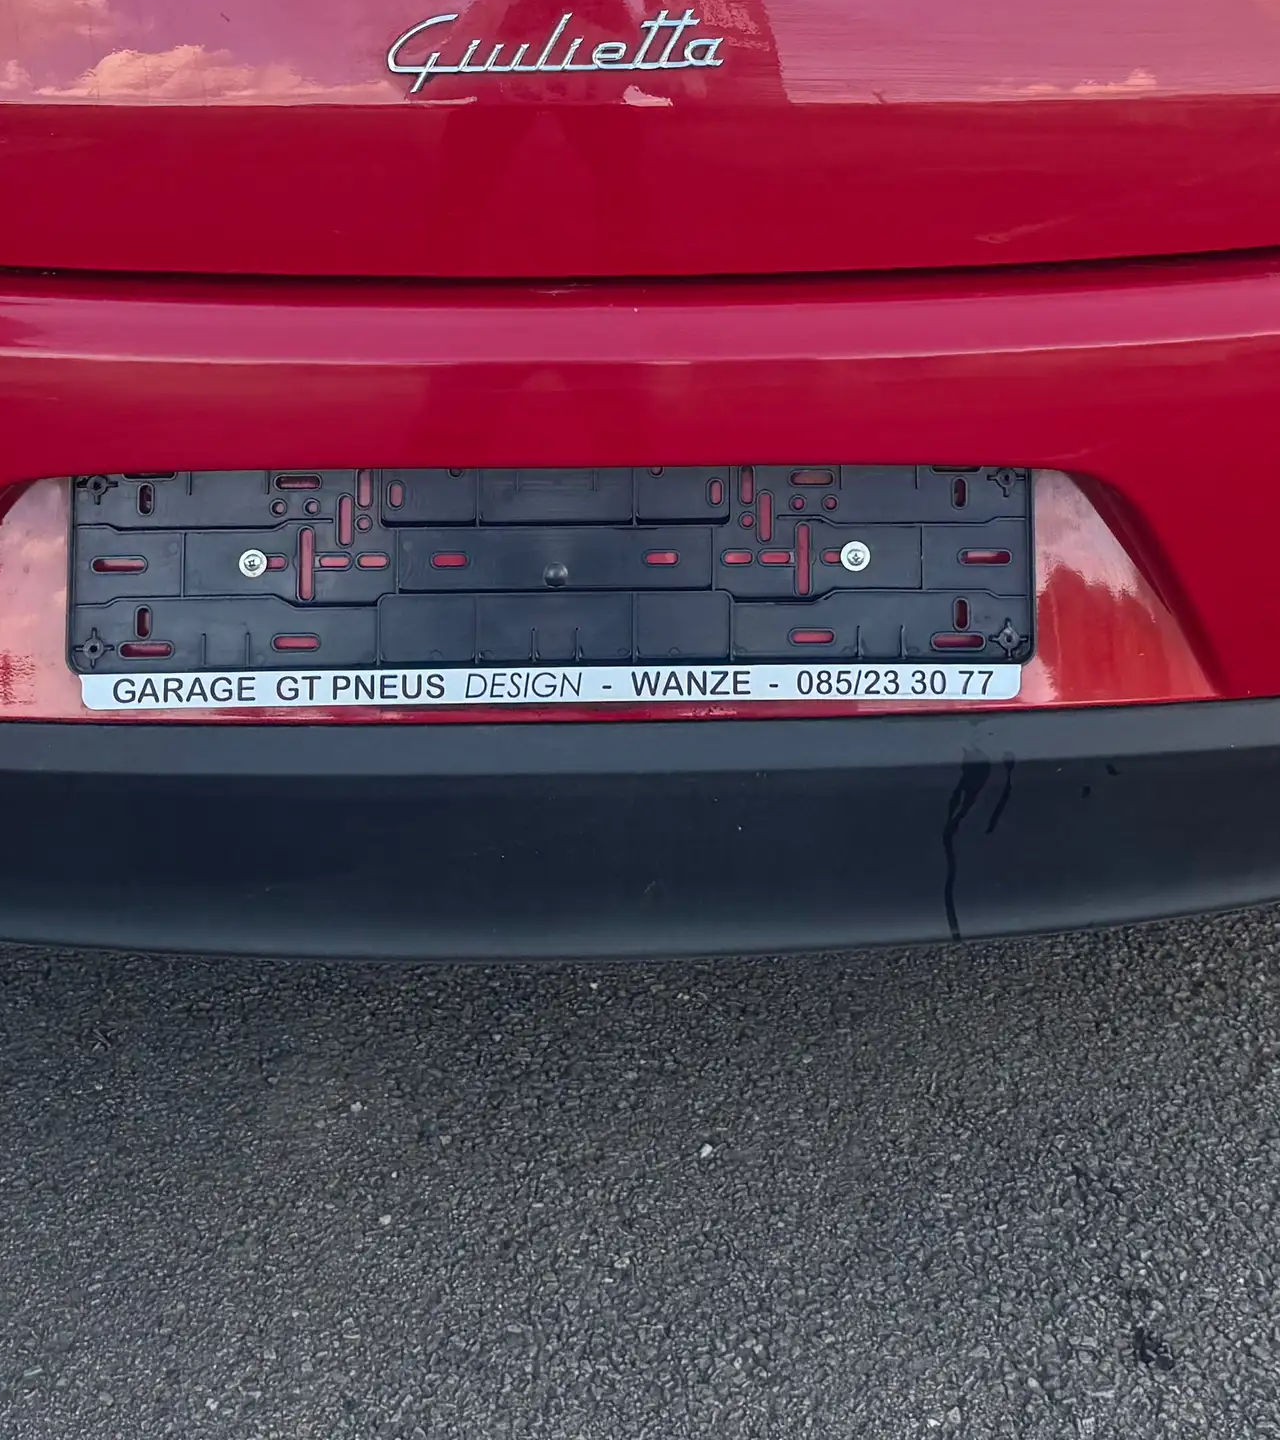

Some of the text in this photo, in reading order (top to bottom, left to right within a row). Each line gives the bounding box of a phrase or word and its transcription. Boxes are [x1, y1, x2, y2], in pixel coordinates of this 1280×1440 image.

[387, 9, 725, 94] Giulietta
[112, 675, 256, 704] GARAGE
[275, 675, 321, 702] GT
[332, 673, 445, 701] PNEUS
[464, 671, 583, 700] DESIGN
[631, 670, 751, 697] WANZE
[796, 669, 900, 696] 085/23
[910, 669, 947, 696] 30
[959, 669, 994, 696] 77
